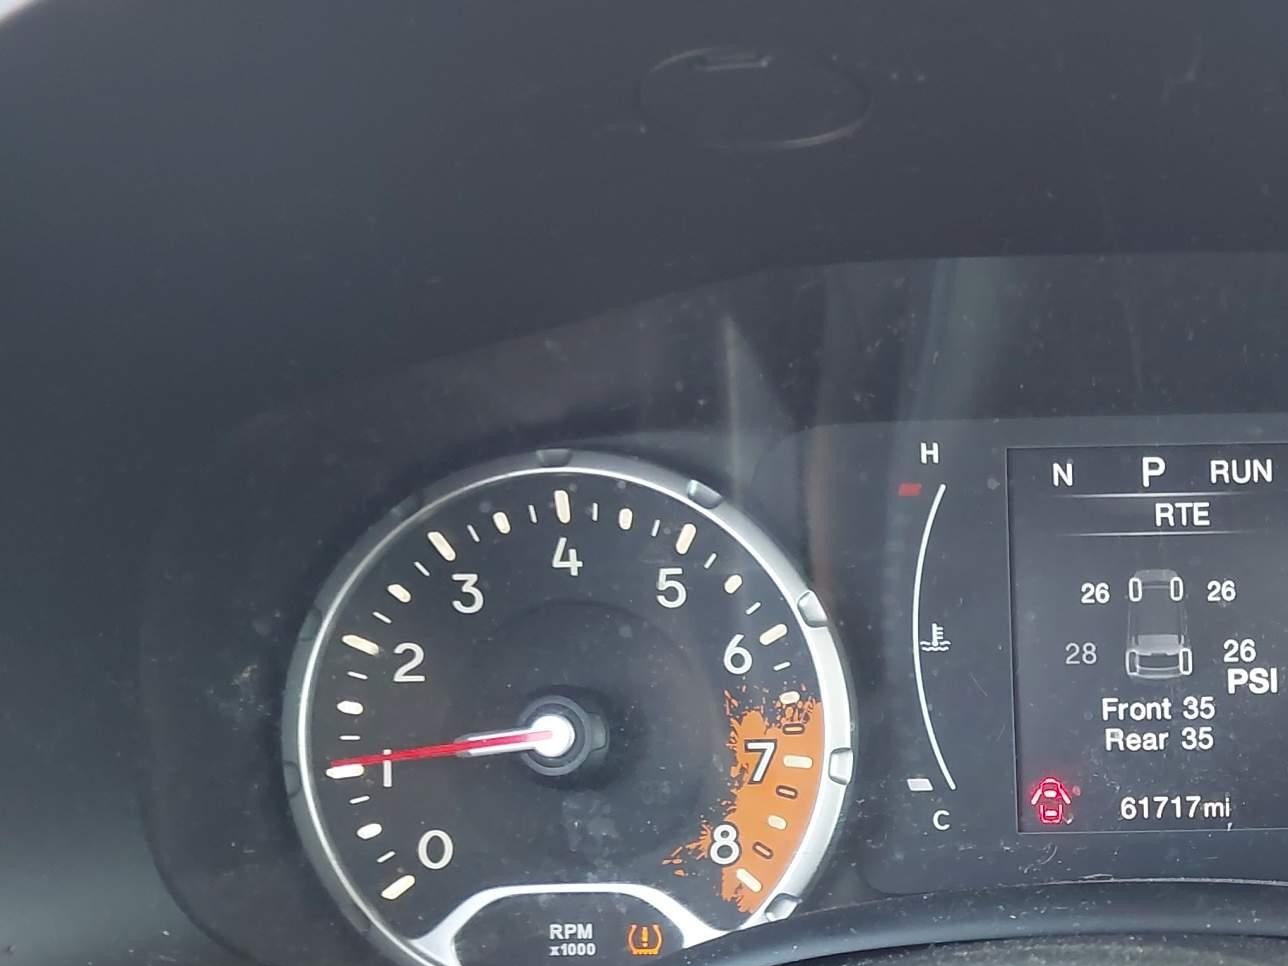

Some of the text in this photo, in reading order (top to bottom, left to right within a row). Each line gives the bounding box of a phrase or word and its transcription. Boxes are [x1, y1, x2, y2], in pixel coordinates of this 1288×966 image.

[921, 443, 938, 463] H
[1053, 457, 1272, 487] N P RUN
[1156, 502, 1210, 526] RTE
[553, 538, 582, 575] 4
[453, 574, 483, 613] 3
[657, 568, 686, 608] 5
[1081, 583, 1109, 603] 26
[1208, 581, 1235, 601] 26
[394, 643, 425, 681] 2
[723, 635, 752, 674] 6
[1066, 643, 1096, 664] 28
[1224, 639, 1256, 662] 26
[1228, 668, 1277, 693] PSI
[1102, 696, 1215, 720] Front 35
[1106, 727, 1213, 750] Rear 35
[743, 739, 777, 785] 7
[933, 810, 949, 830] C
[418, 830, 453, 869] 0
[708, 823, 741, 866] 8
[550, 924, 593, 939] RPM
[550, 943, 596, 956] x1000
